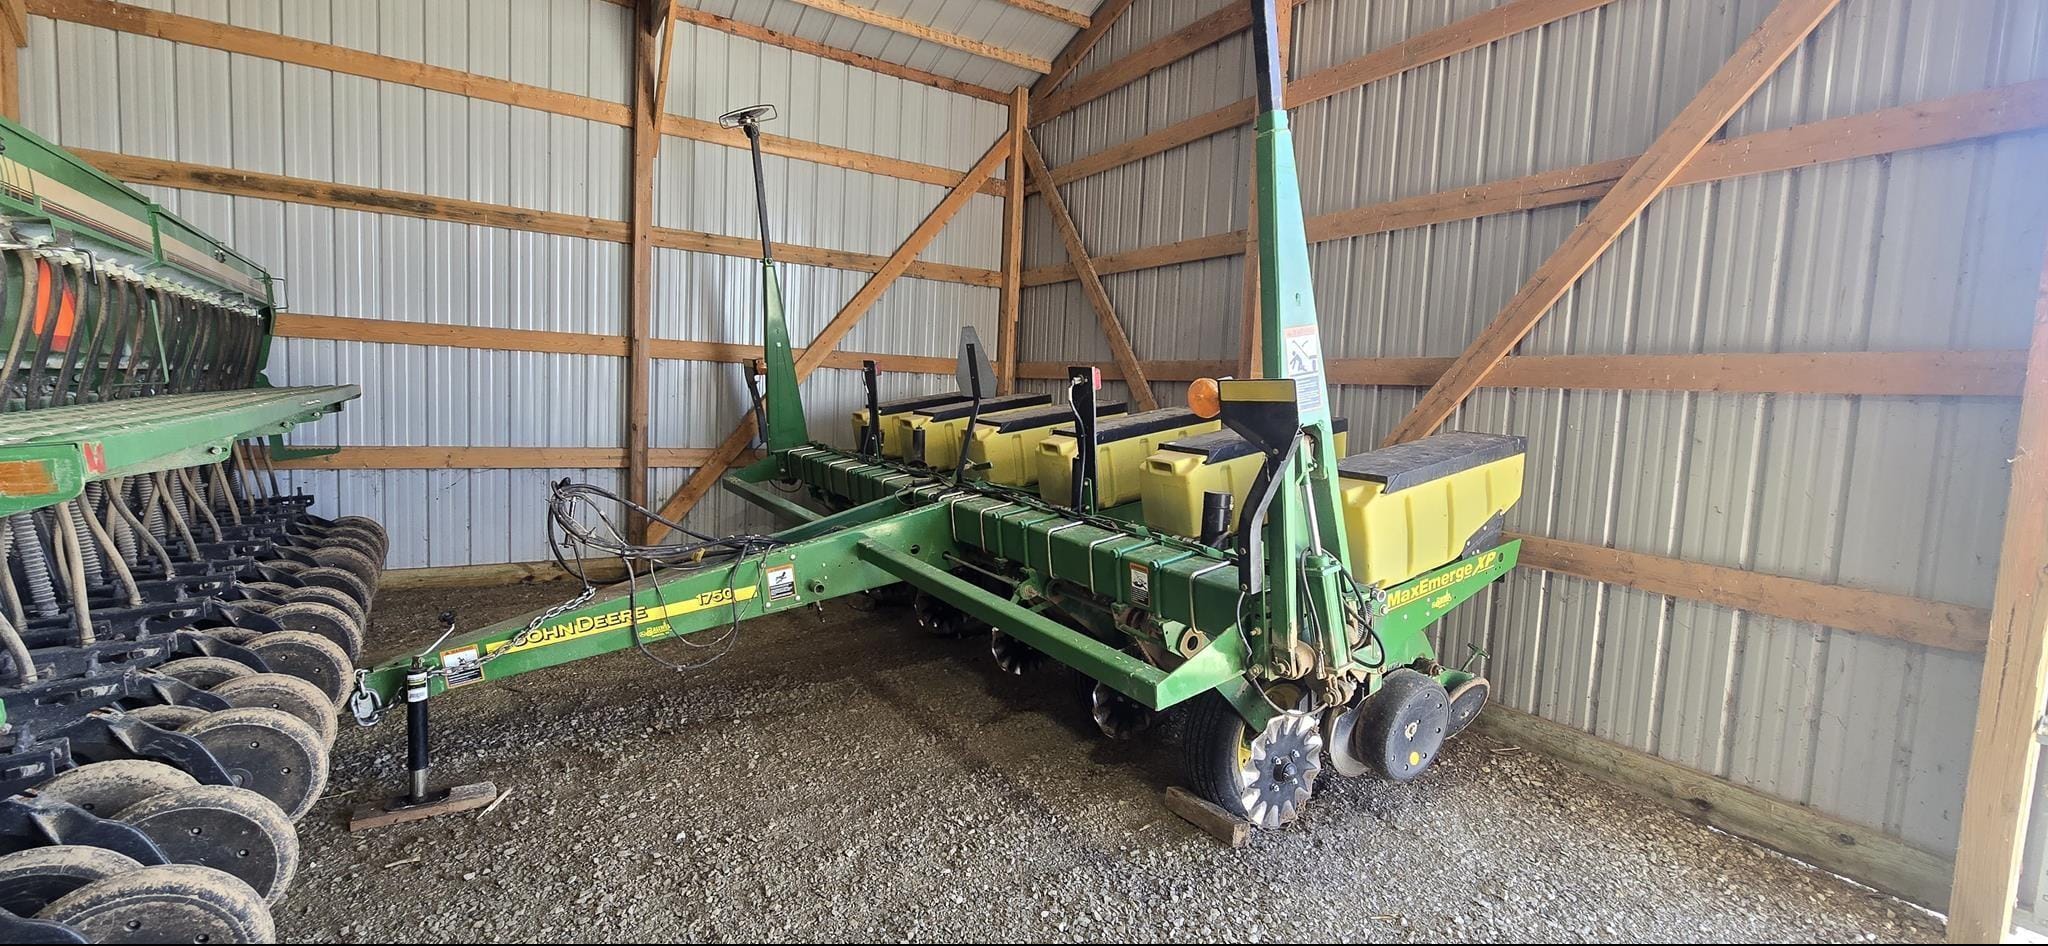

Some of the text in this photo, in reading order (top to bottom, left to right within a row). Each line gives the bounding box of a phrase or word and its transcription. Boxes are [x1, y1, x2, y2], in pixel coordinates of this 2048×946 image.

[1386, 561, 1474, 609] MaxEmerge
[1472, 551, 1497, 576] XP
[696, 587, 733, 606] 1750
[576, 606, 649, 633] DEERE
